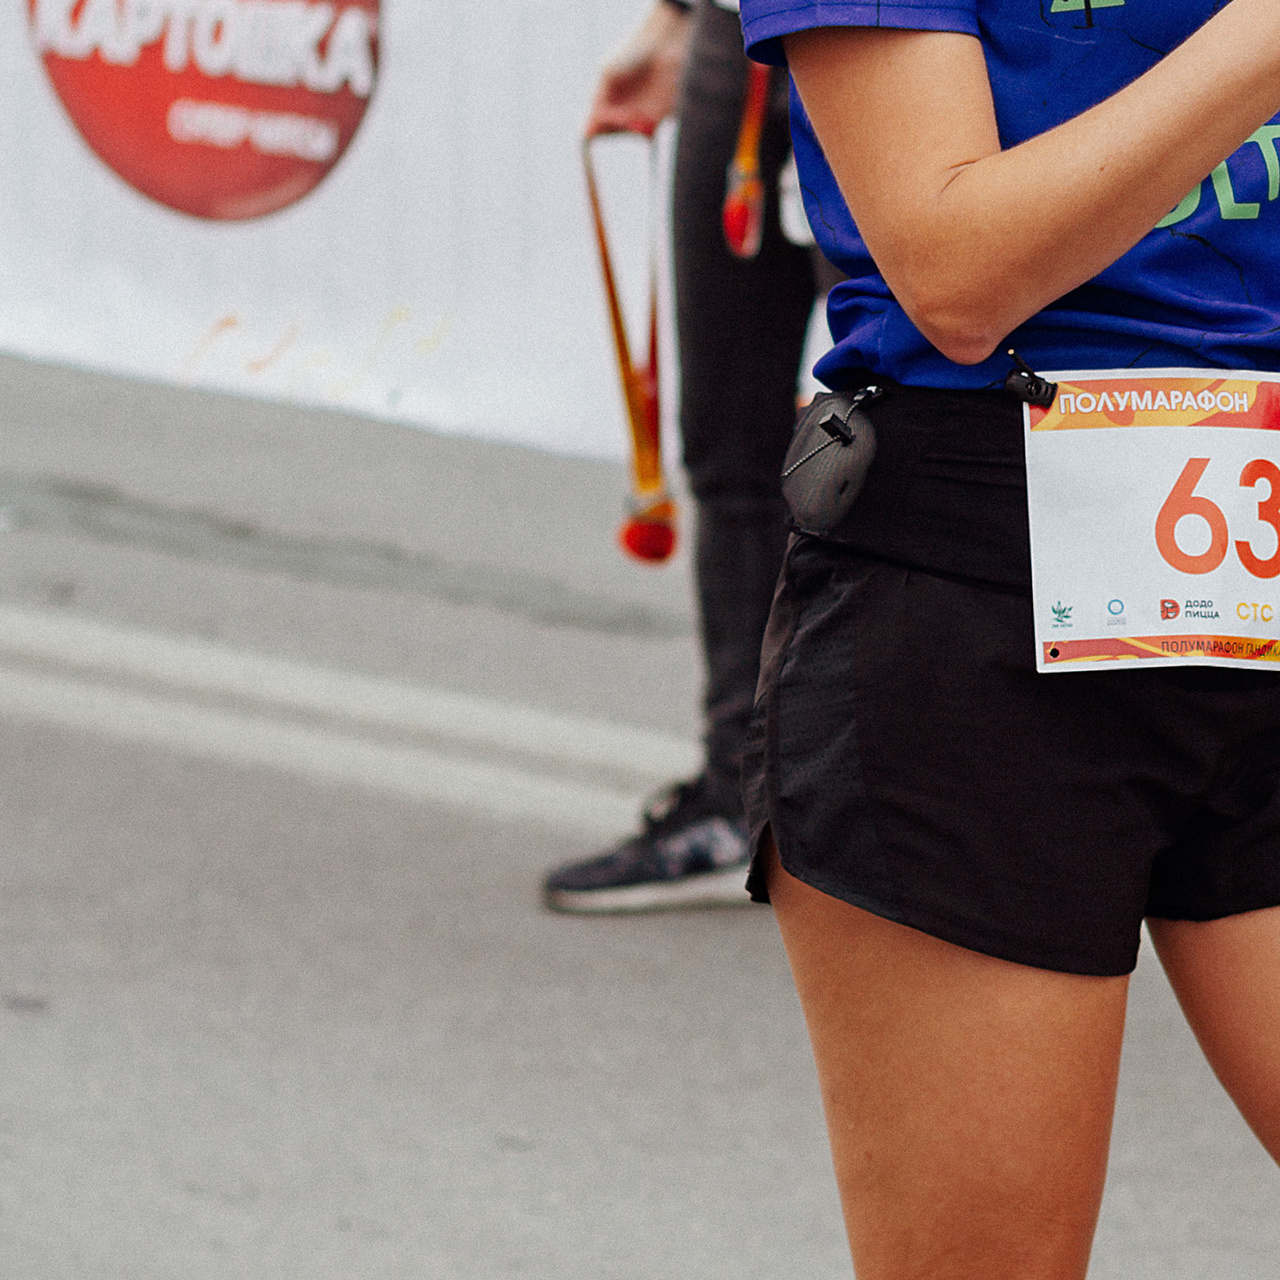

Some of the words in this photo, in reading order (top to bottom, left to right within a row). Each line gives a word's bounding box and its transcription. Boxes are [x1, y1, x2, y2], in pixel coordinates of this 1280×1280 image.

[1059, 390, 1249, 415] ПОЛУМАРАФОН
[1185, 600, 1214, 609] ДОДО
[1236, 602, 1274, 623] СТС
[1185, 610, 1220, 619] ПИЦЦА
[1161, 640, 1244, 656] ПОЛУМАРАФОН
